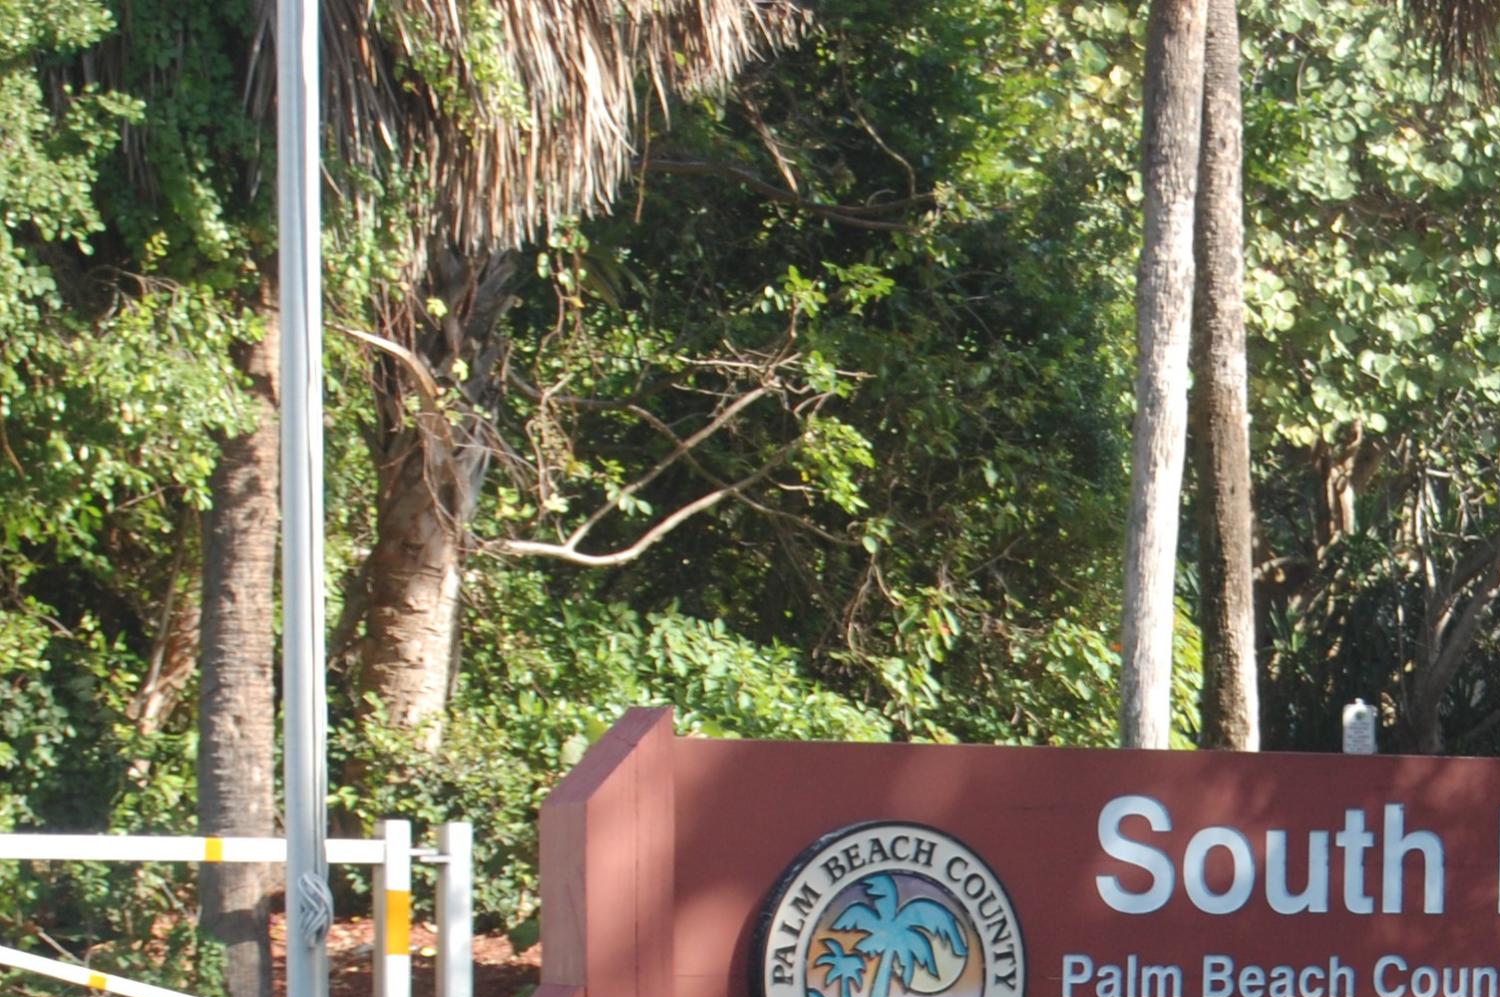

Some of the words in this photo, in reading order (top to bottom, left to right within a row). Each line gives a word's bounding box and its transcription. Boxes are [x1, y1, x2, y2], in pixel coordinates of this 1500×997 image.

[772, 882, 823, 985] PALM
[820, 835, 938, 884] BEACH
[945, 856, 1017, 991] COUNTY
[1096, 794, 1445, 915] South
